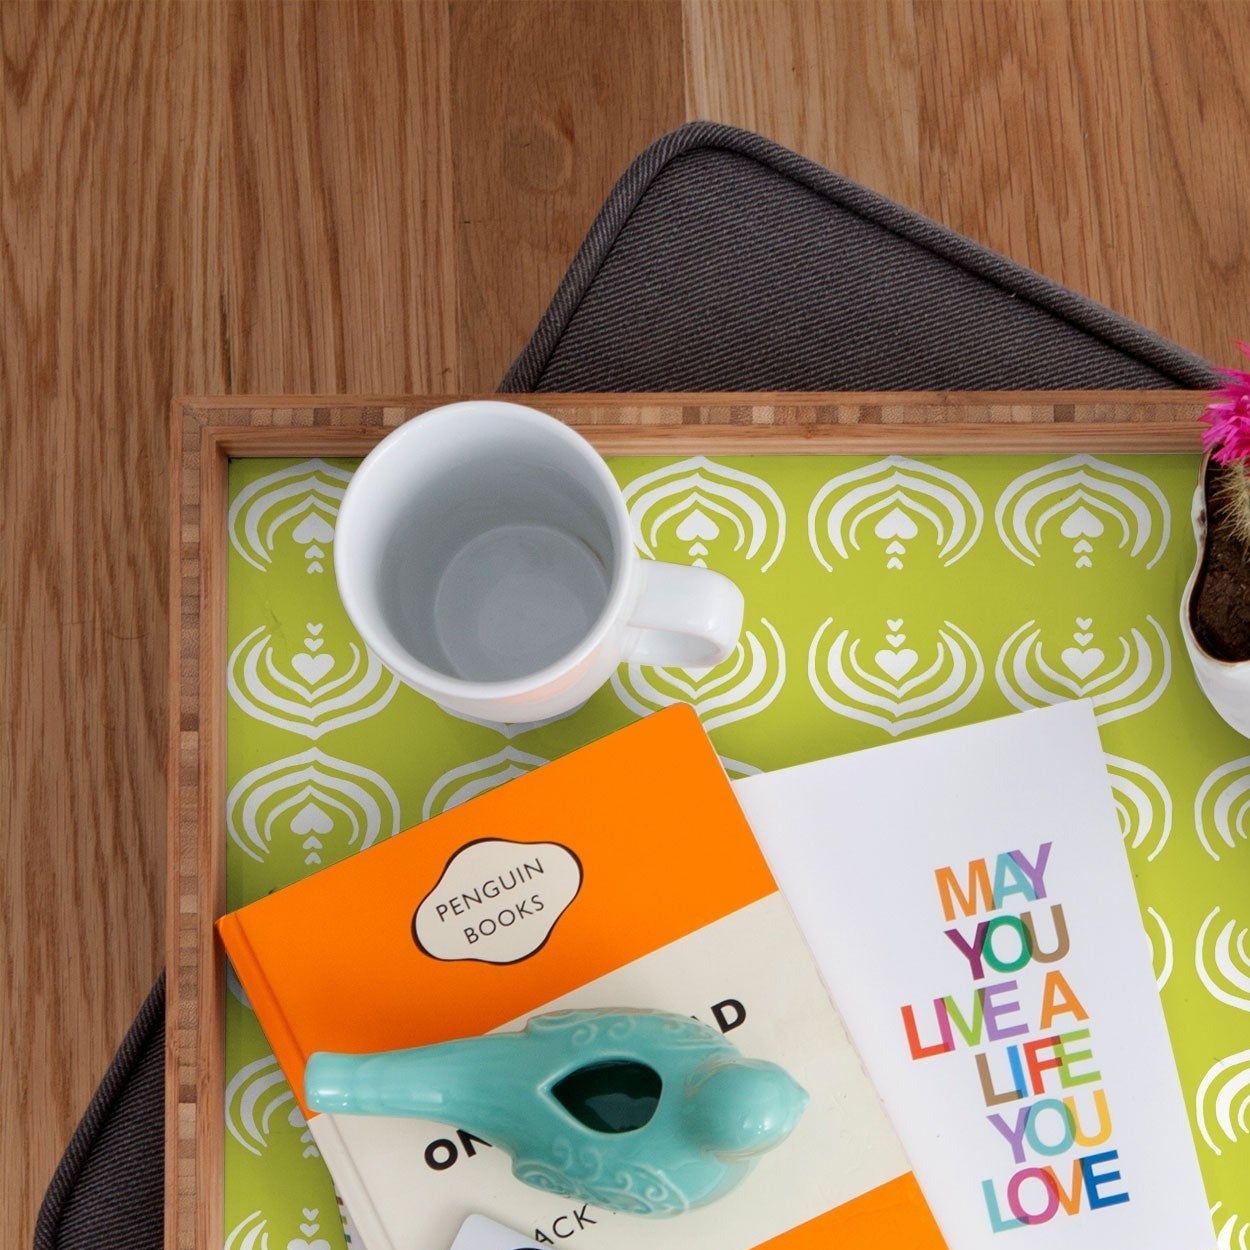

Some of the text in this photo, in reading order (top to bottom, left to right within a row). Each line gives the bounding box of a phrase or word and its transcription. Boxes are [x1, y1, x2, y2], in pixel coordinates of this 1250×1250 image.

[435, 858, 545, 922] PENGUIN
[463, 894, 545, 944] BOOKS
[934, 841, 1053, 922] MAY
[943, 903, 1070, 981] YOU
[900, 970, 1090, 1061] LIVE A
[974, 1028, 1102, 1107] LIFE
[986, 1089, 1112, 1164] YOU
[534, 1203, 598, 1245] ACK
[981, 1149, 1130, 1233] LOVE
